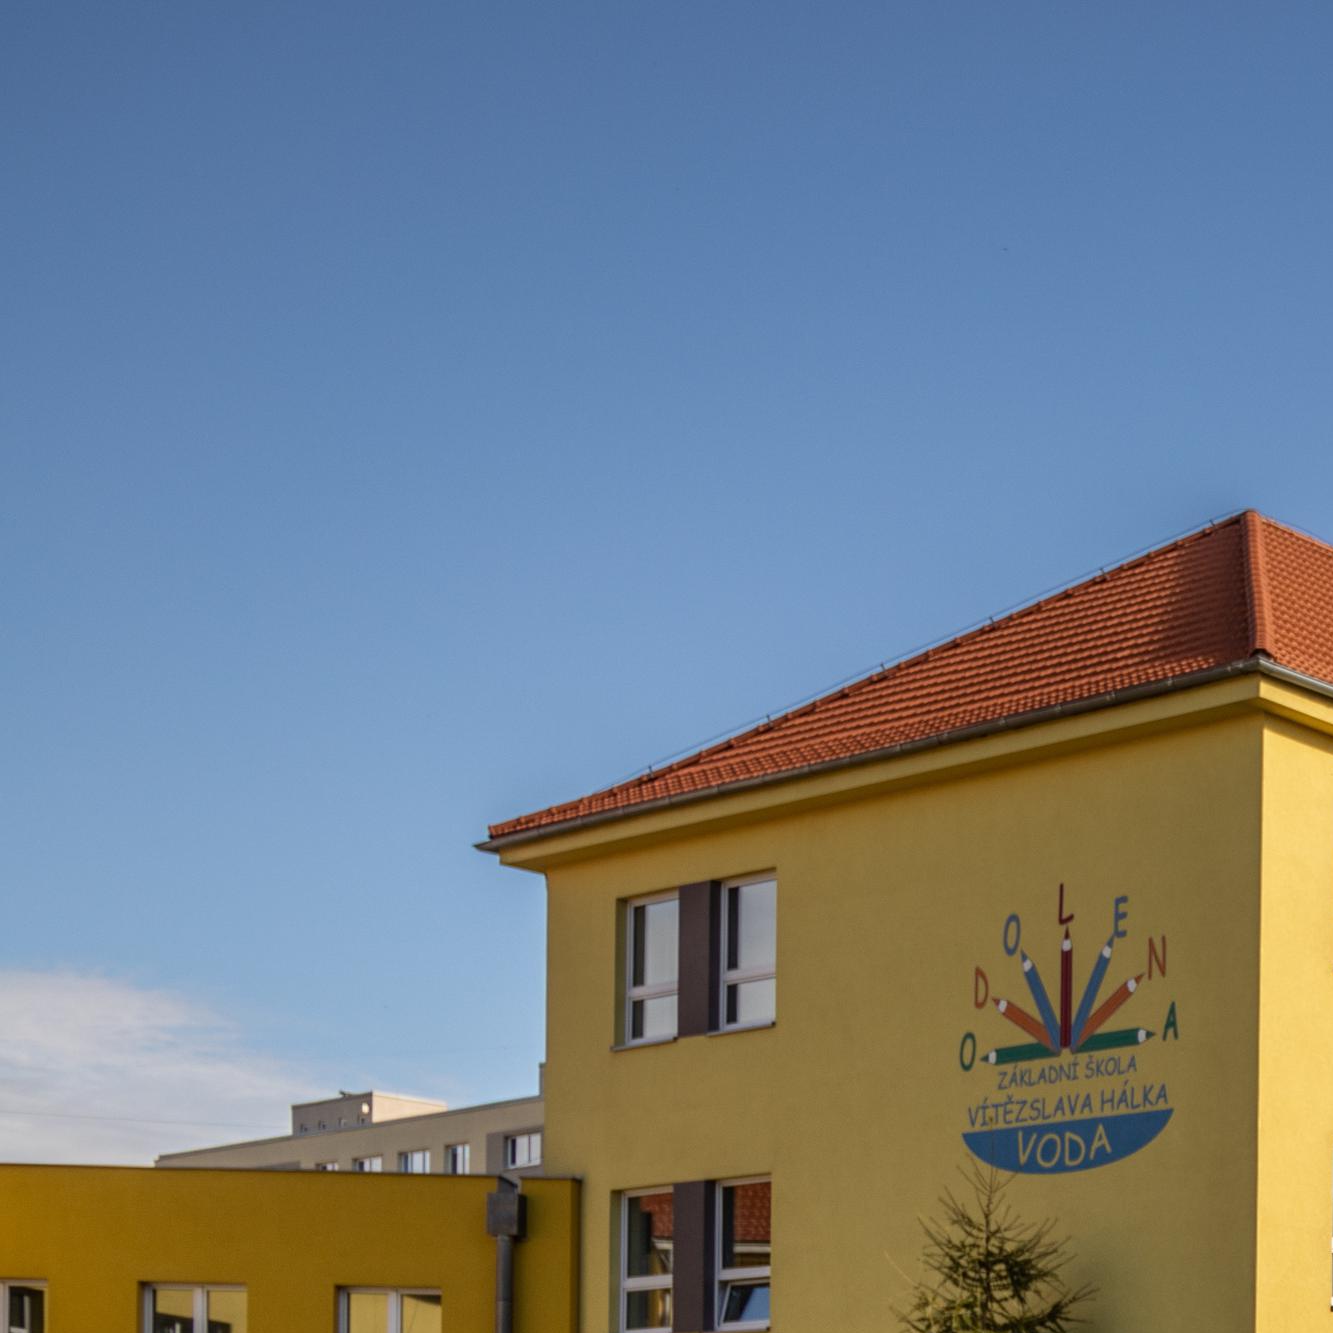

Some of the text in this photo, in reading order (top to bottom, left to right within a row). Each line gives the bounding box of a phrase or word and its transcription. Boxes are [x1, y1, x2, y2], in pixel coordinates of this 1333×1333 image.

[997, 1055, 1137, 1090] ZÁKLADNÍ ŠKOLA
[967, 1080, 1169, 1128] VÍTĚZSLAVA HÁLKA
[1018, 1123, 1112, 1168] VODA
